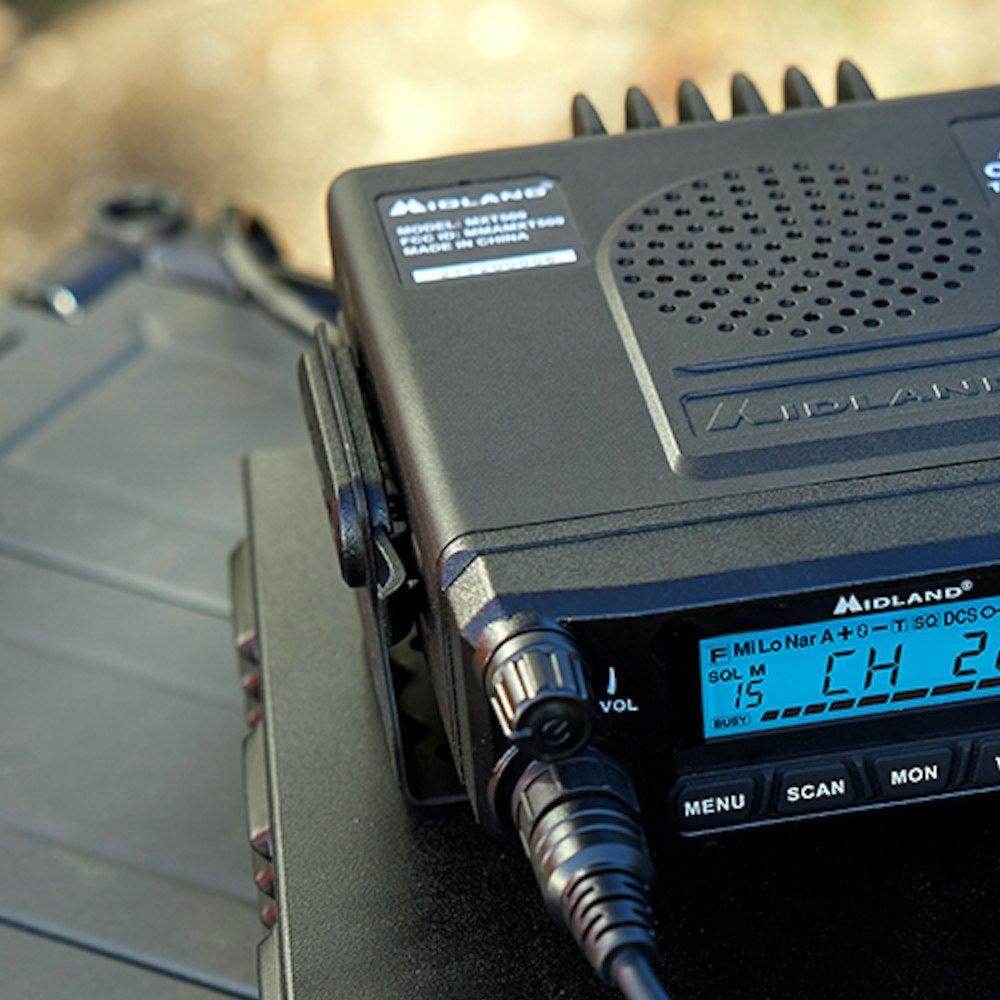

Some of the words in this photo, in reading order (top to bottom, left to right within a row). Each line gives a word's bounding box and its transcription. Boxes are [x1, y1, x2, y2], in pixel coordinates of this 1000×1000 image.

[402, 240, 452, 257] MADE
[455, 236, 474, 250] IN
[476, 231, 530, 248] CHINA
[785, 633, 818, 649] Nar
[914, 614, 938, 630] SQ
[943, 607, 978, 626] DCS
[708, 667, 742, 683] SQL
[822, 643, 903, 696] CH
[735, 678, 763, 709] 15
[599, 698, 639, 713] VOL
[713, 716, 747, 729] BUSY
[891, 765, 938, 785] MON
[786, 779, 846, 802] SCAN
[684, 793, 746, 817] MENU
